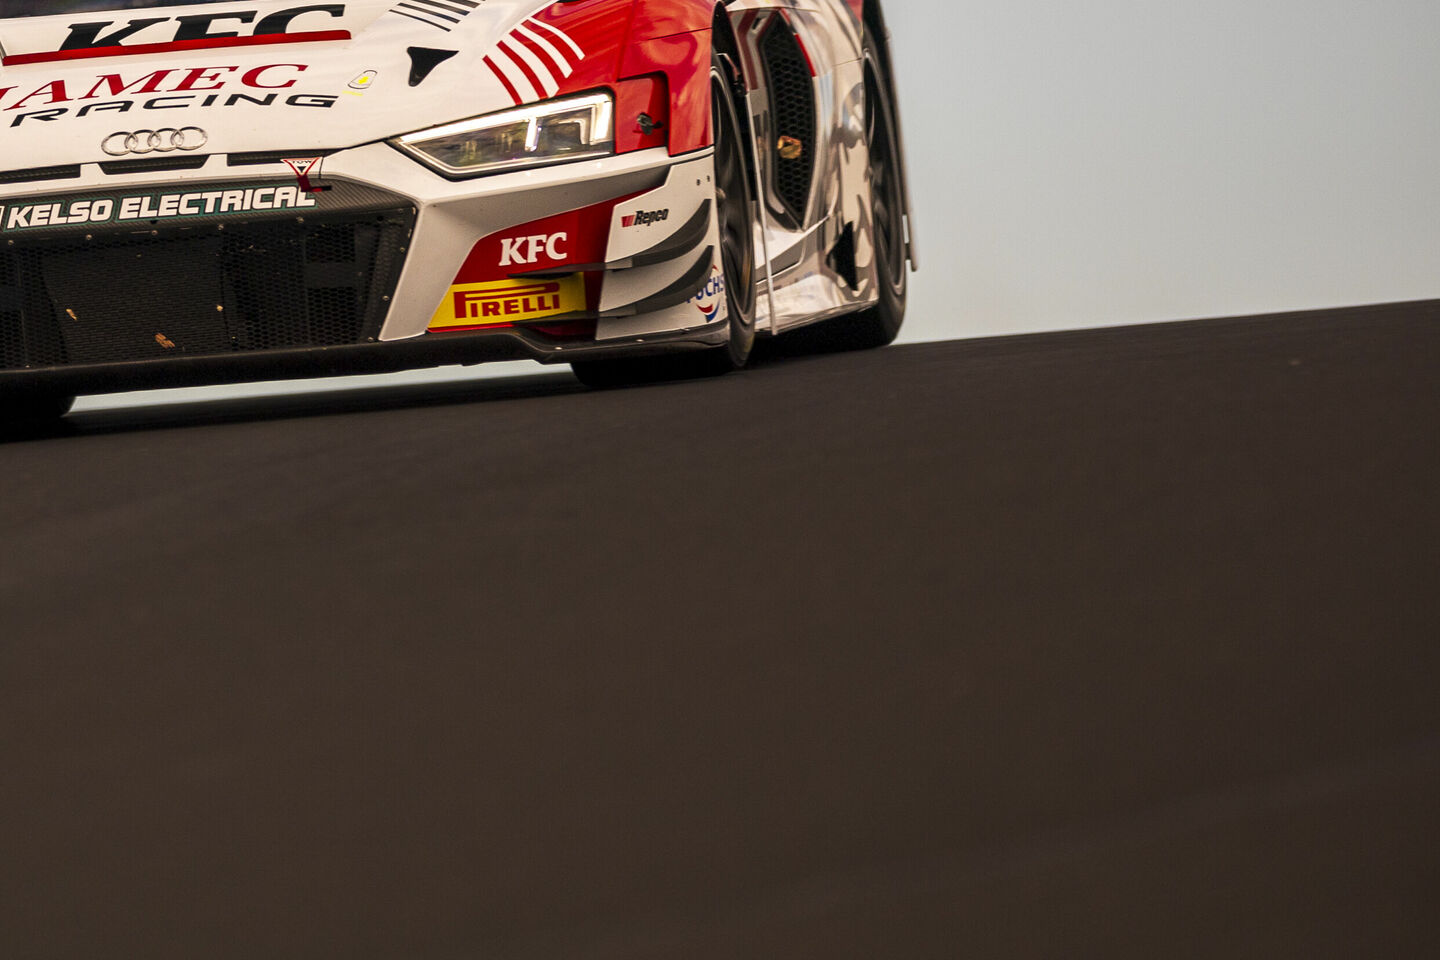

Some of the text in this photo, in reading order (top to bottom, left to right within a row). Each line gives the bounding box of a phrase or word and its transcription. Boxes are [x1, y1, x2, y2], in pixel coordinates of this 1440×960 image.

[10, 93, 339, 127] RACING
[7, 186, 315, 229] KELSO ELECTRICAL
[633, 208, 669, 227] Repco
[498, 232, 567, 266] KFC
[453, 282, 560, 319] PIRELLI
[686, 272, 725, 304] UCHS
